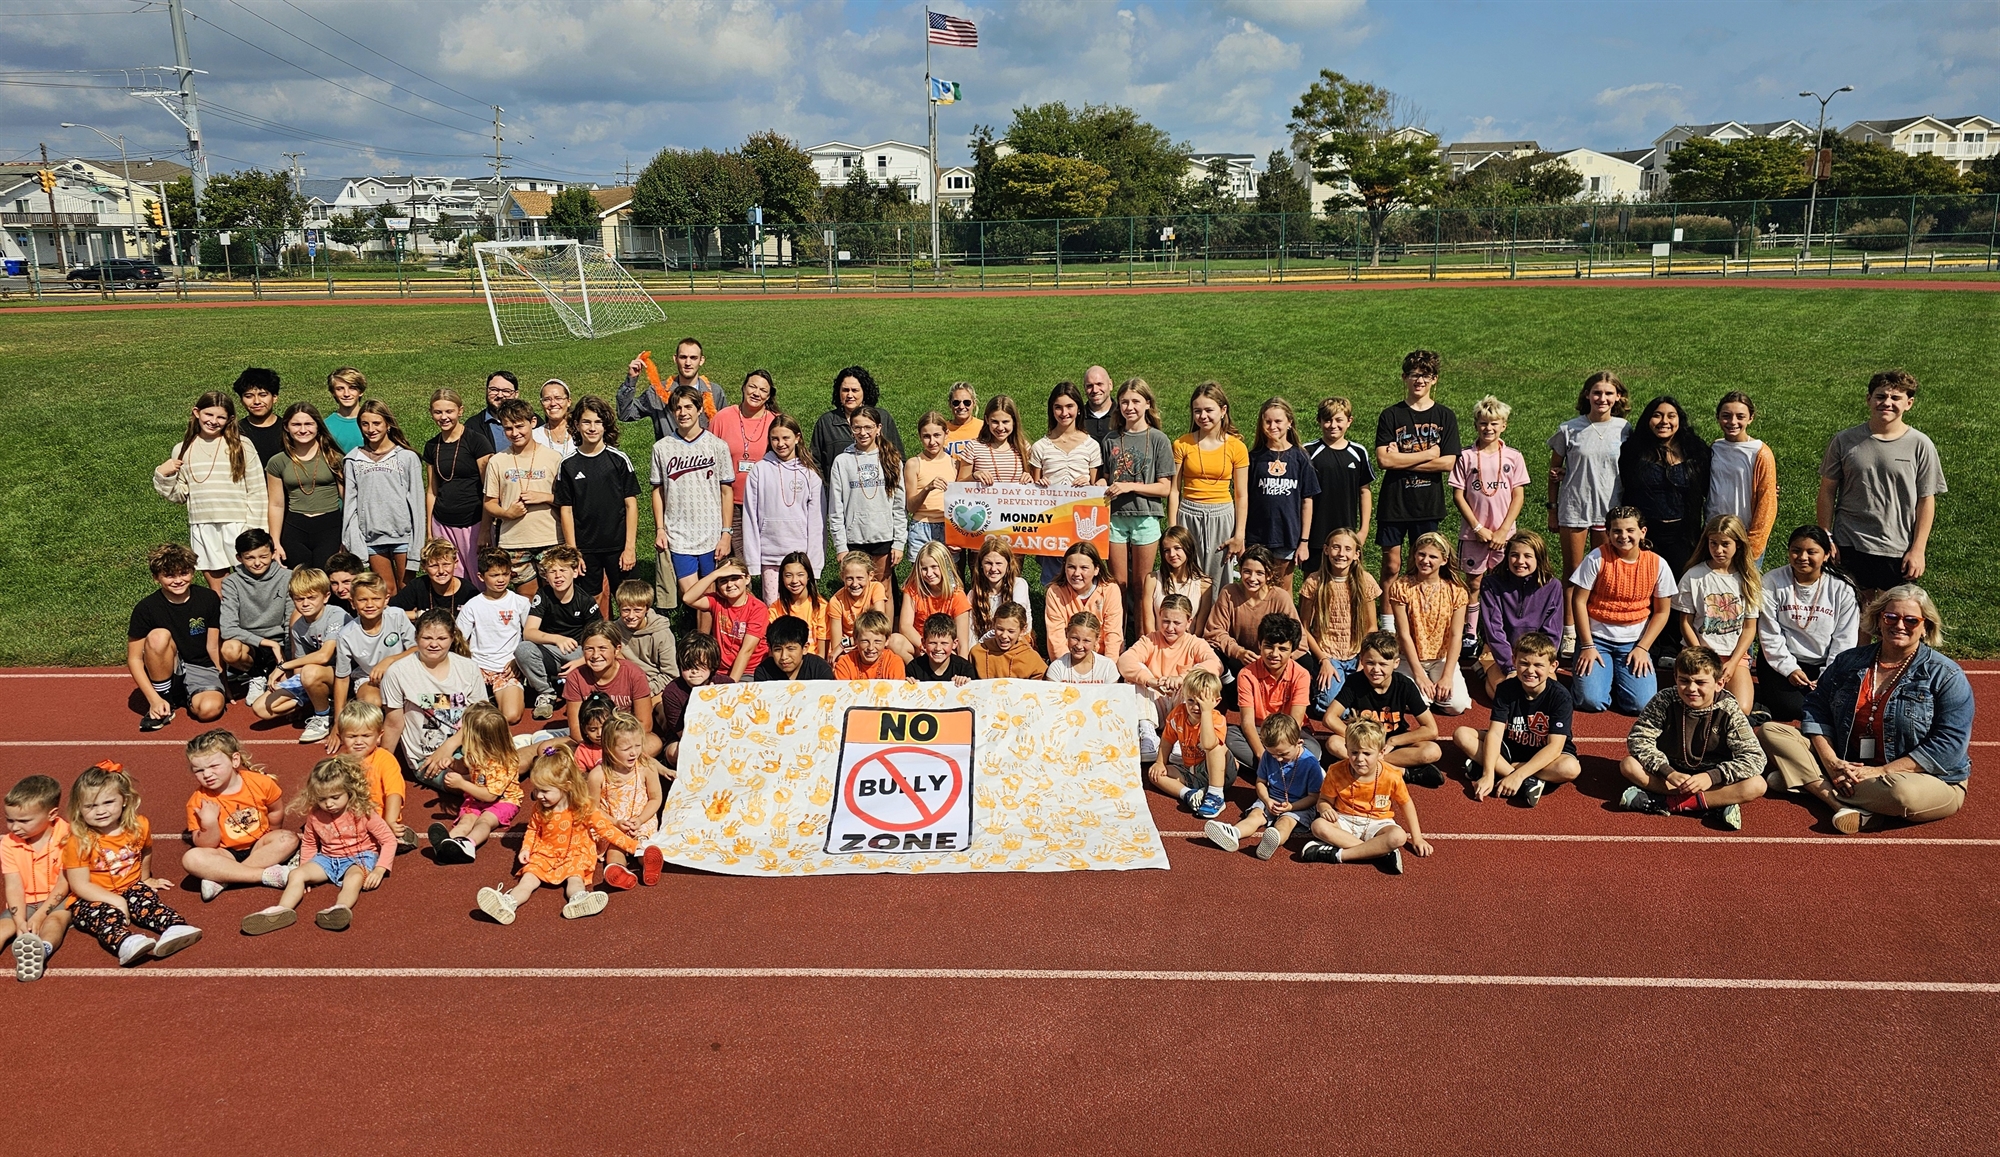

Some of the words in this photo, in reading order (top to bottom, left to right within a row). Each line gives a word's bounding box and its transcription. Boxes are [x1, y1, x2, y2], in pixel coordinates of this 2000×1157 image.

[666, 455, 715, 475] Phillies
[1258, 477, 1298, 489] AUBURN
[964, 487, 999, 495] WORLD
[1001, 488, 1022, 496] DAY
[1039, 489, 1087, 498] BULLYING
[1262, 486, 1292, 496] TIGERS
[997, 498, 1057, 506] PREVENTION
[1000, 512, 1054, 524] MONDAY
[1012, 525, 1039, 533] wear
[1815, 605, 1834, 617] EAGL
[1360, 709, 1401, 723] GAME
[879, 712, 938, 742] NO
[858, 774, 948, 797] BULY
[839, 832, 957, 851] ZONE
